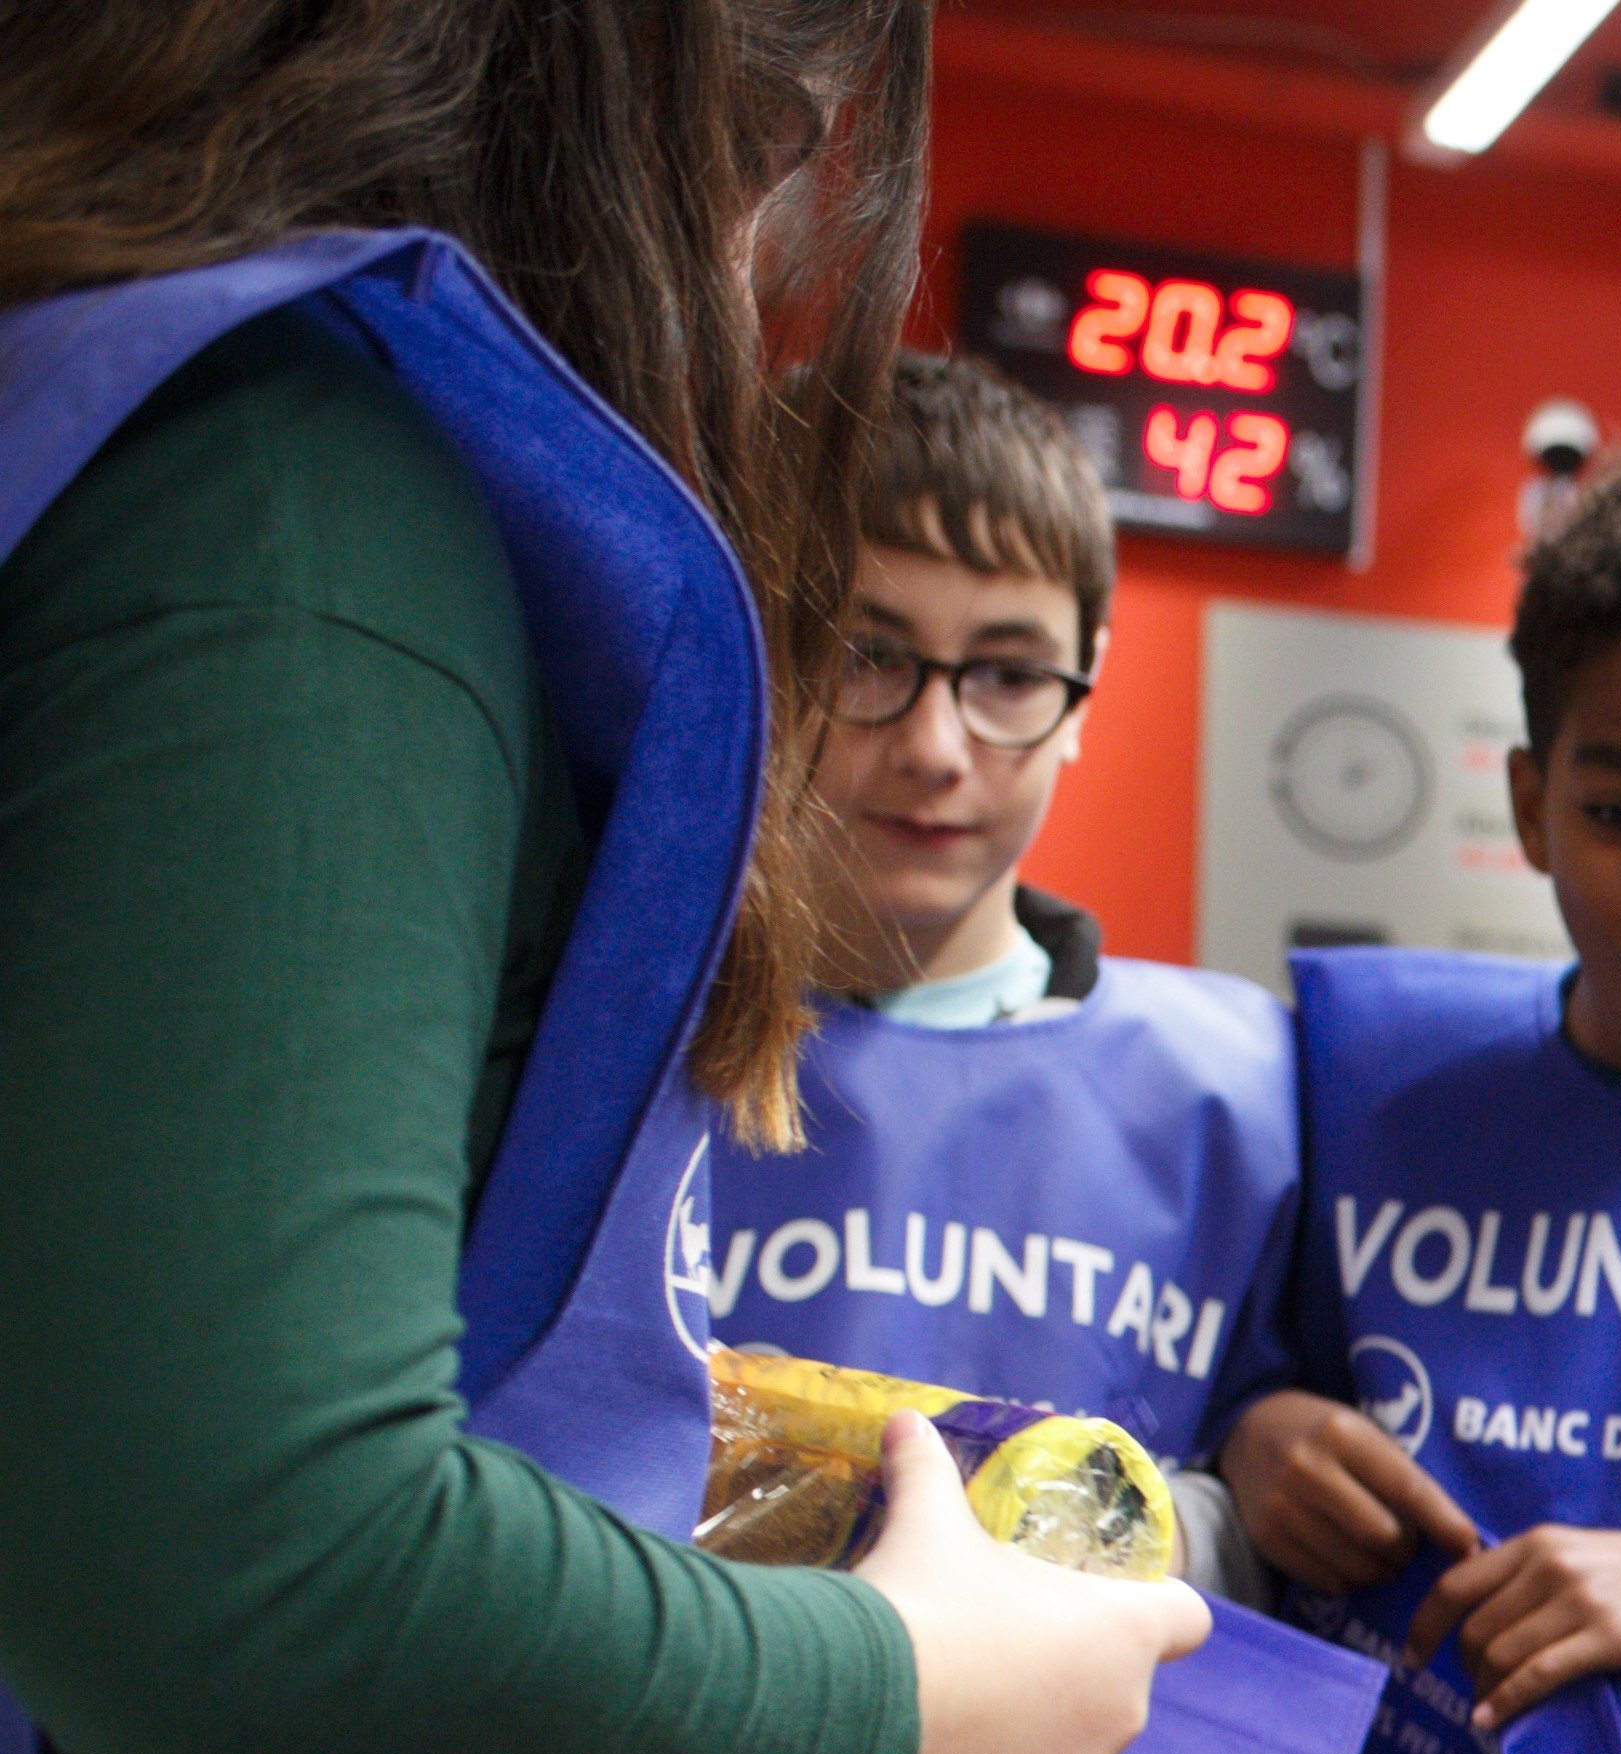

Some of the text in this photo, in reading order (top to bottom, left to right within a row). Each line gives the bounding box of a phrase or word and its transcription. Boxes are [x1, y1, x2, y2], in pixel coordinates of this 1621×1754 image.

[1067, 267, 1295, 393] 20.2
[1142, 402, 1290, 515] 42
[1455, 1396, 1589, 1458] BANC
